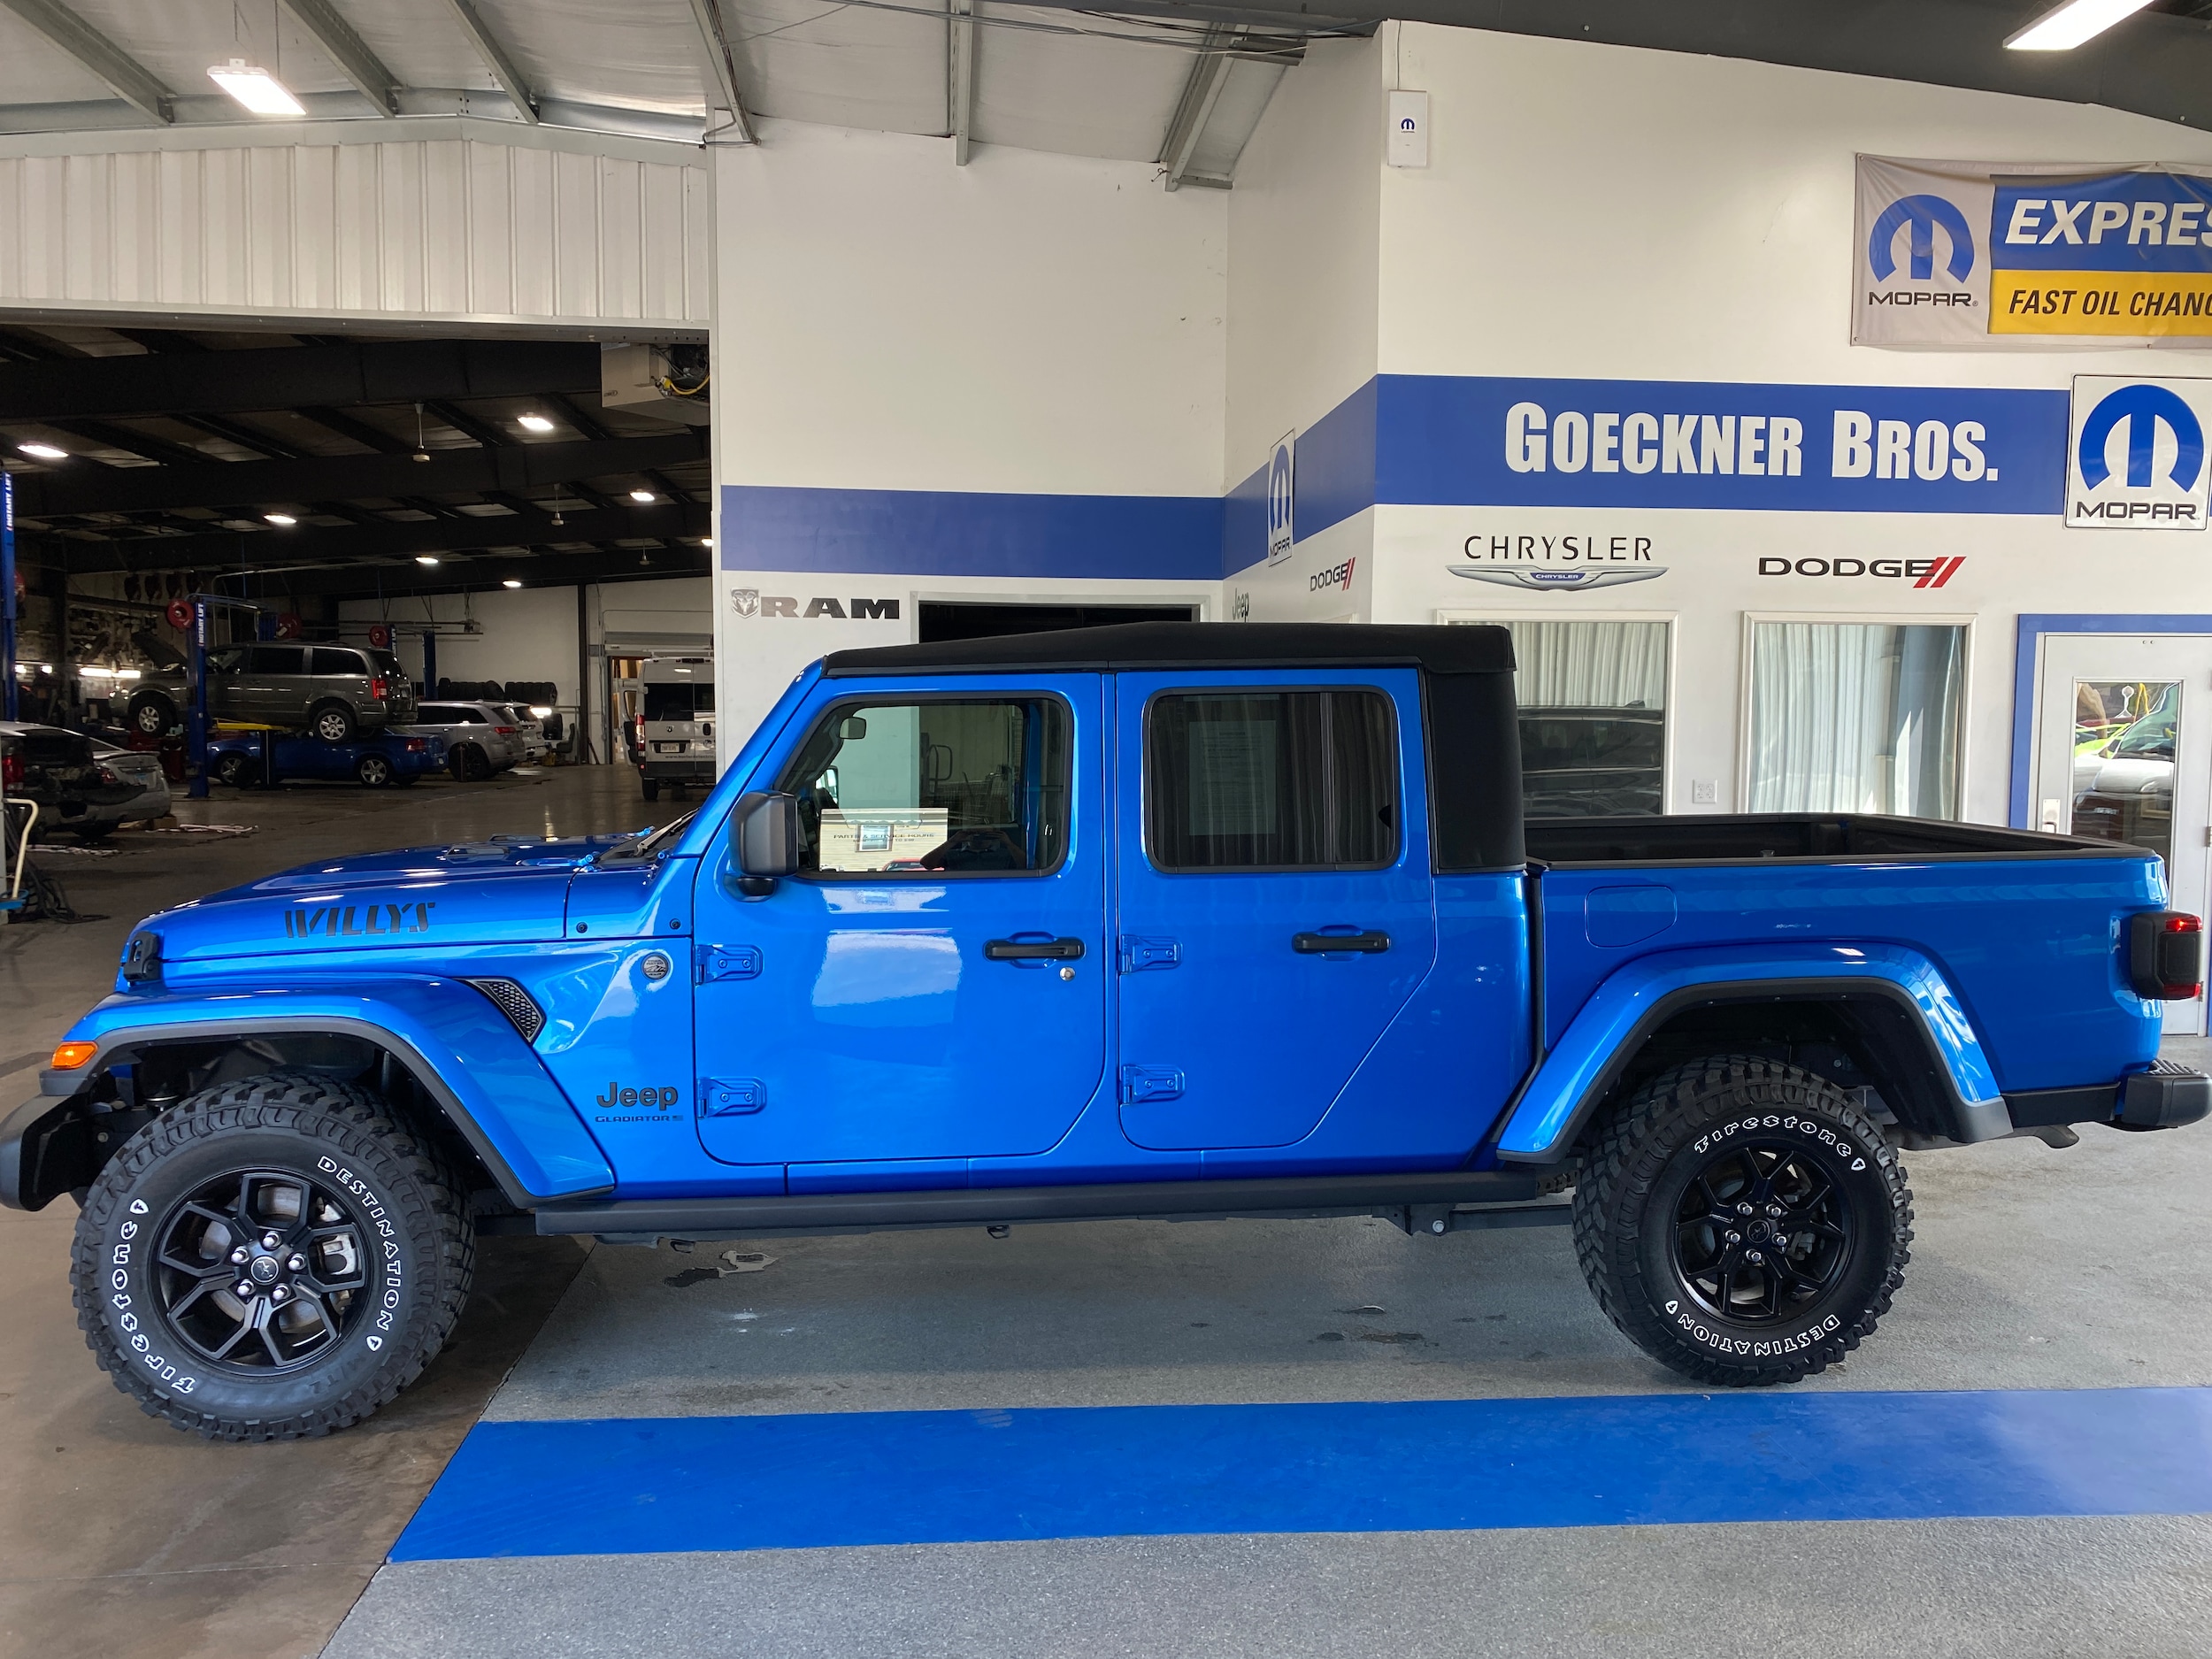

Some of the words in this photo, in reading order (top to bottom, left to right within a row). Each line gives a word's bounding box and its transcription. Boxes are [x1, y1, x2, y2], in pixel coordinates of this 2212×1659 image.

[2008, 290, 2077, 315] FAST
[2082, 291, 2121, 316] OIL
[1505, 401, 1803, 477] GOECKNER
[1832, 410, 1999, 481] BROS.
[2076, 501, 2198, 520] MOPAR
[1269, 536, 1290, 557] MOPAR
[1464, 535, 1652, 561] CHRYSLER
[1310, 562, 1349, 592] DODGE
[1758, 557, 1937, 578] DODGE
[760, 595, 900, 619] RAM
[1232, 588, 1249, 623] Jeep
[284, 901, 436, 939] WILLYS
[595, 1081, 679, 1111] Jeep
[1694, 1115, 1852, 1157] Firestone
[317, 1156, 403, 1331] DESTINATION
[111, 1220, 197, 1394] Firestone
[1677, 1313, 1841, 1356] DESTINATION
